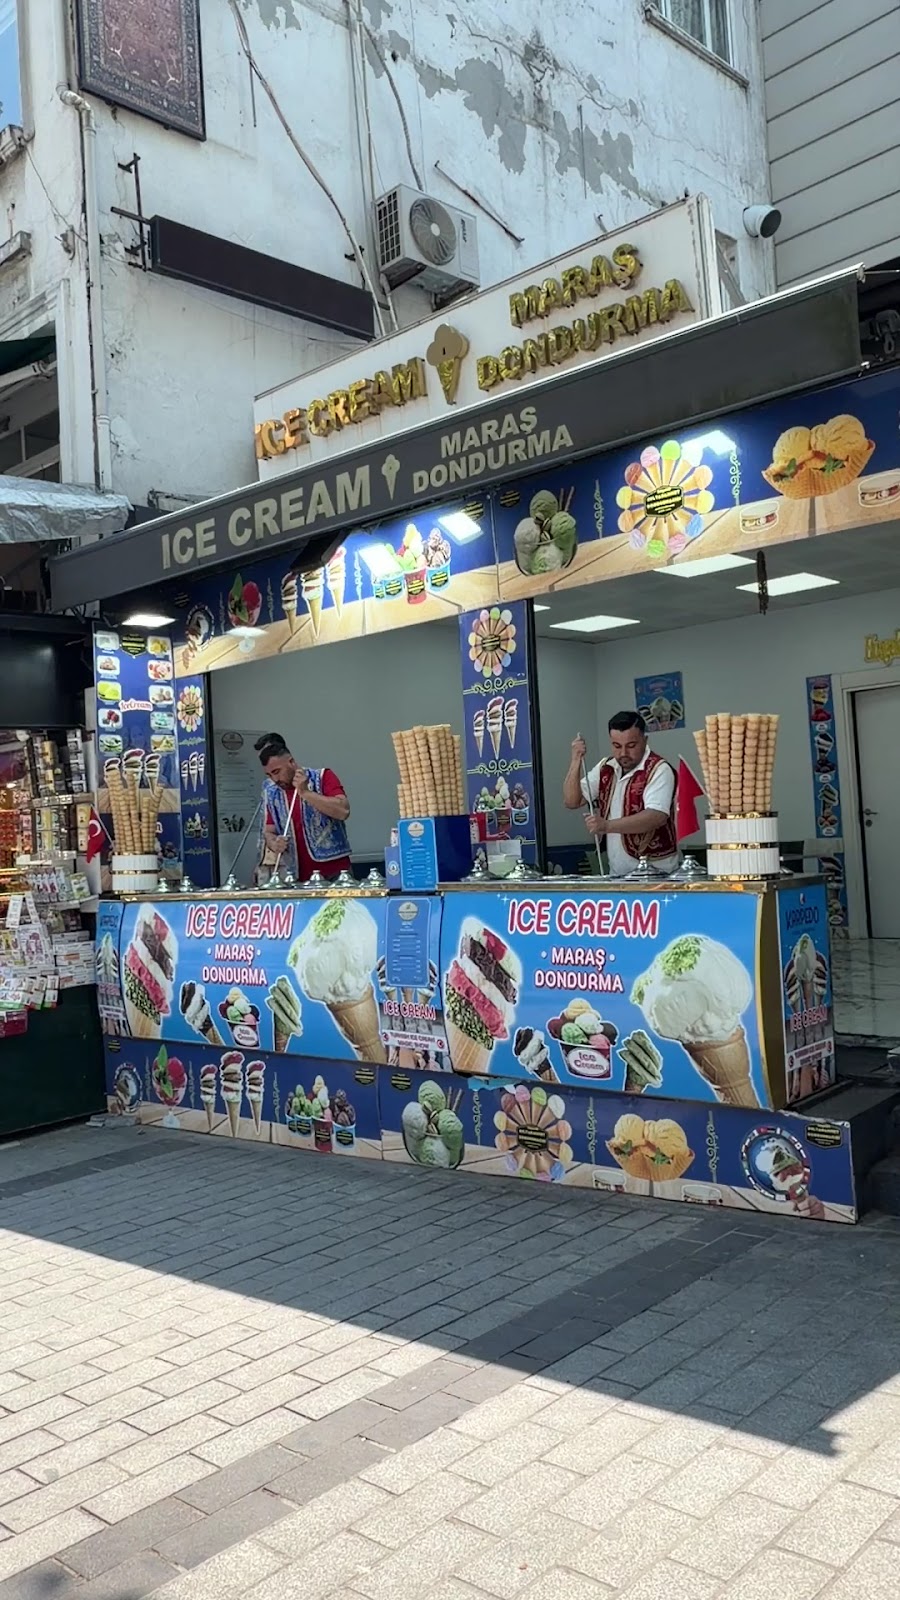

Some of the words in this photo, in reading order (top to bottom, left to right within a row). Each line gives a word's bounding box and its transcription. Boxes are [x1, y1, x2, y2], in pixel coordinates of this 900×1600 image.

[476, 279, 695, 391] DONDURMA
[255, 408, 310, 460] ICE
[307, 357, 428, 437] CREAM
[441, 406, 538, 459] MARAŞ
[413, 424, 575, 495] DONDURMA
[161, 518, 217, 571] ICE
[227, 465, 372, 547] CREAM
[185, 904, 218, 937] ICE
[220, 903, 294, 939] CREAM
[508, 899, 552, 935] ICE
[556, 899, 660, 938] CREAM
[214, 944, 255, 965] MARAŞ
[551, 947, 606, 971] MARAŞ
[202, 966, 268, 986] DONDURMA
[535, 970, 624, 992] DONDURMA
[383, 999, 400, 1016] ICE
[400, 1001, 436, 1021] CREAM
[574, 1059, 605, 1070] Cream
[579, 1052, 596, 1062] Ice
